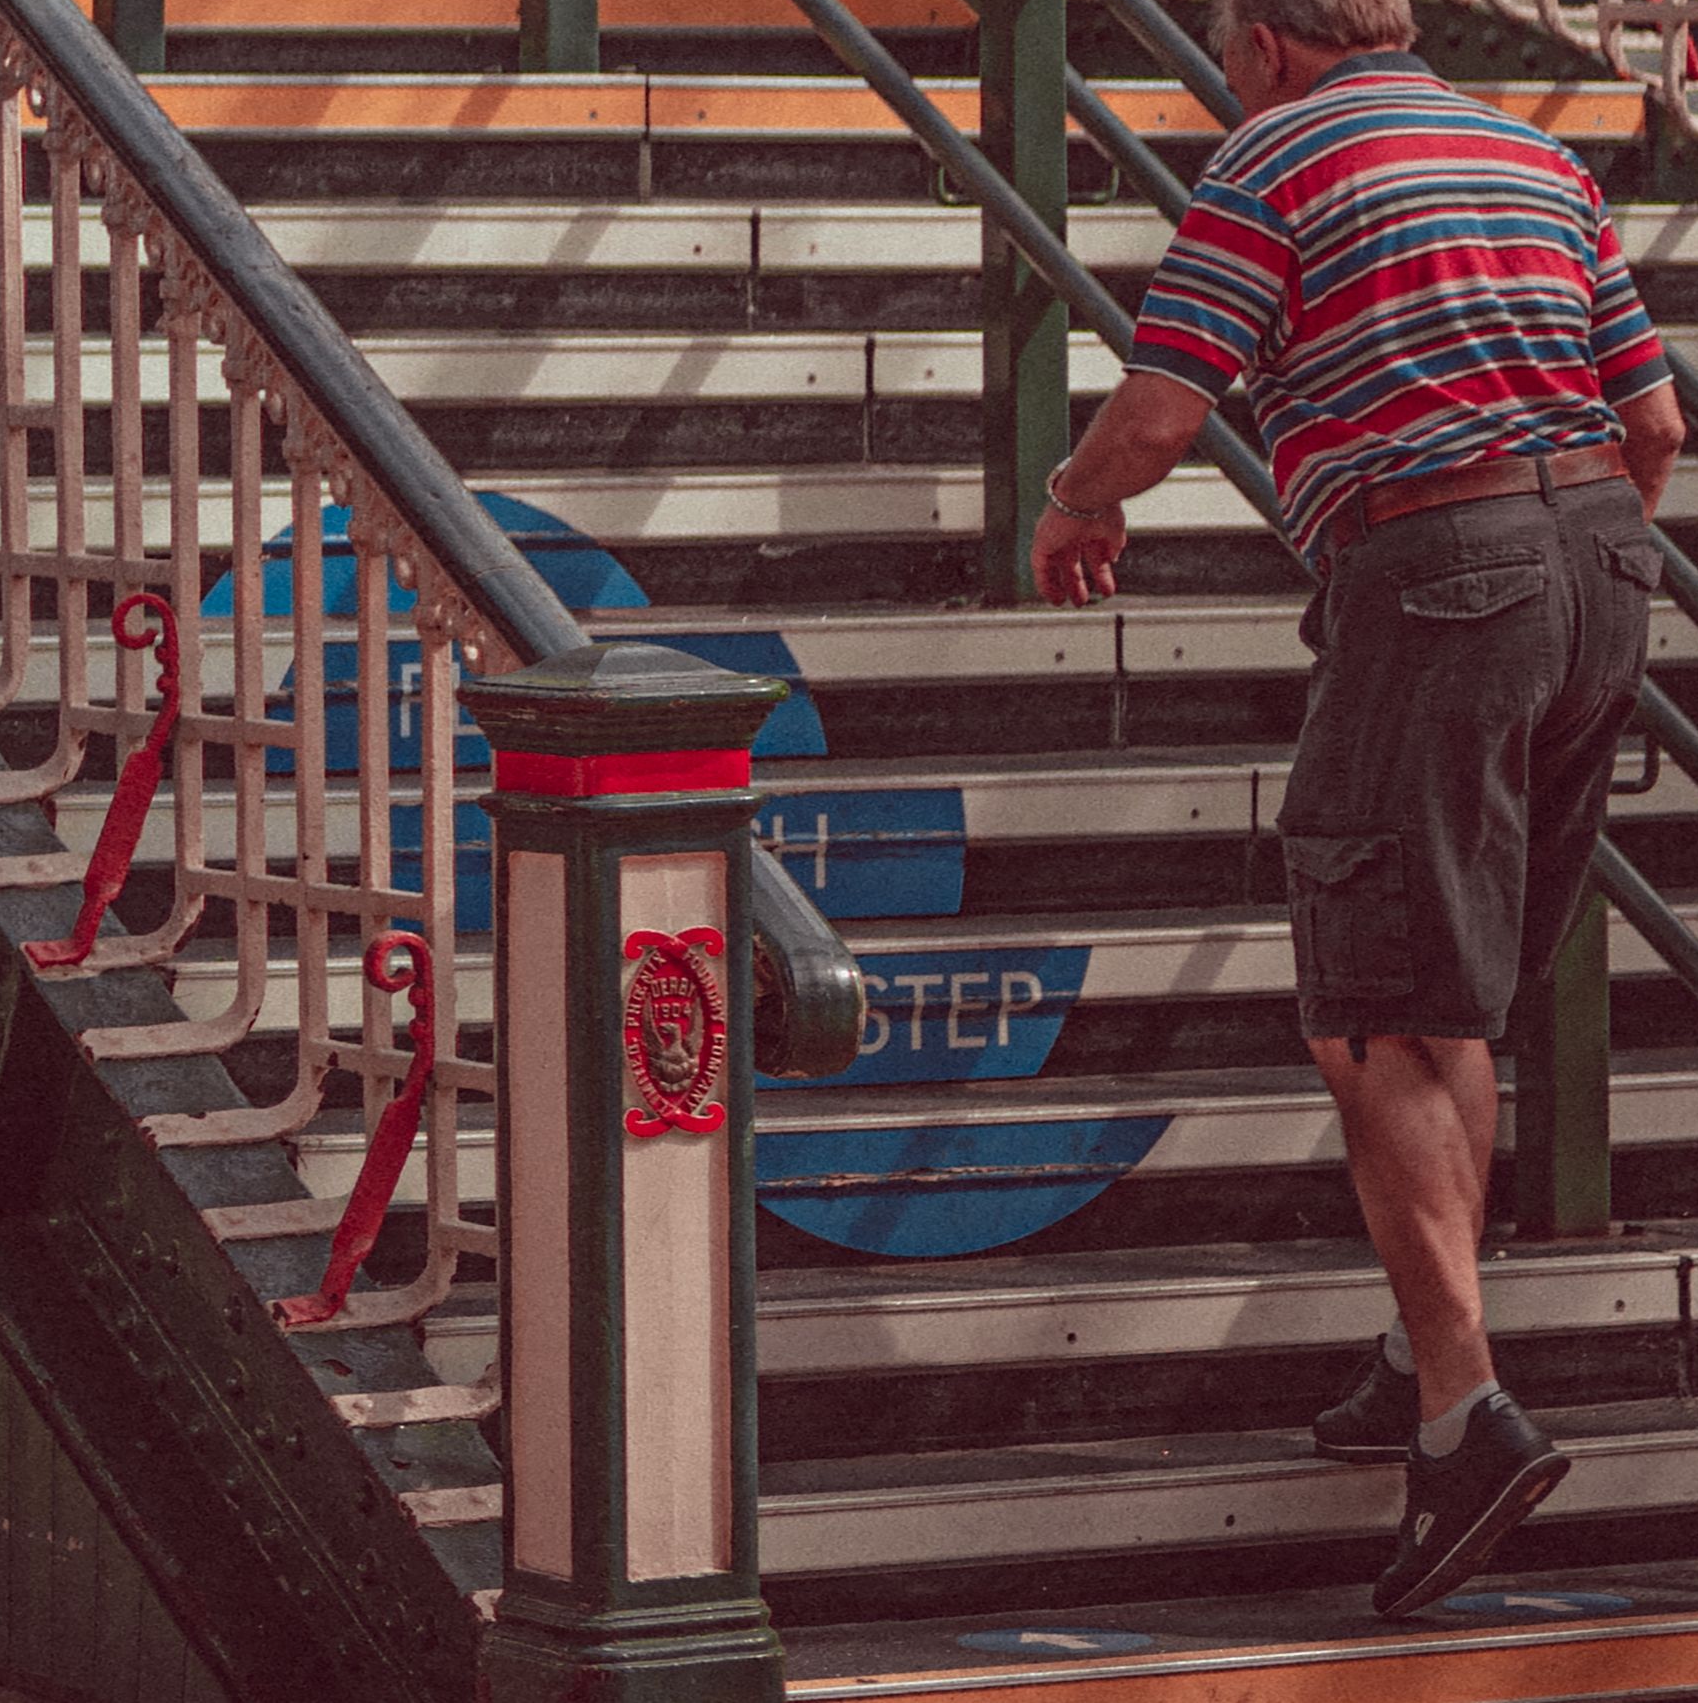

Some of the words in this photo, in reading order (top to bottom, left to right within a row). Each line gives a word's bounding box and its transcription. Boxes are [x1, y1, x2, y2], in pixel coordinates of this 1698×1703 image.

[650, 976, 697, 998] DERBY
[653, 1002, 693, 1019] 1904
[860, 971, 1042, 1055] STEP
[685, 1033, 727, 1113] COMPANY
